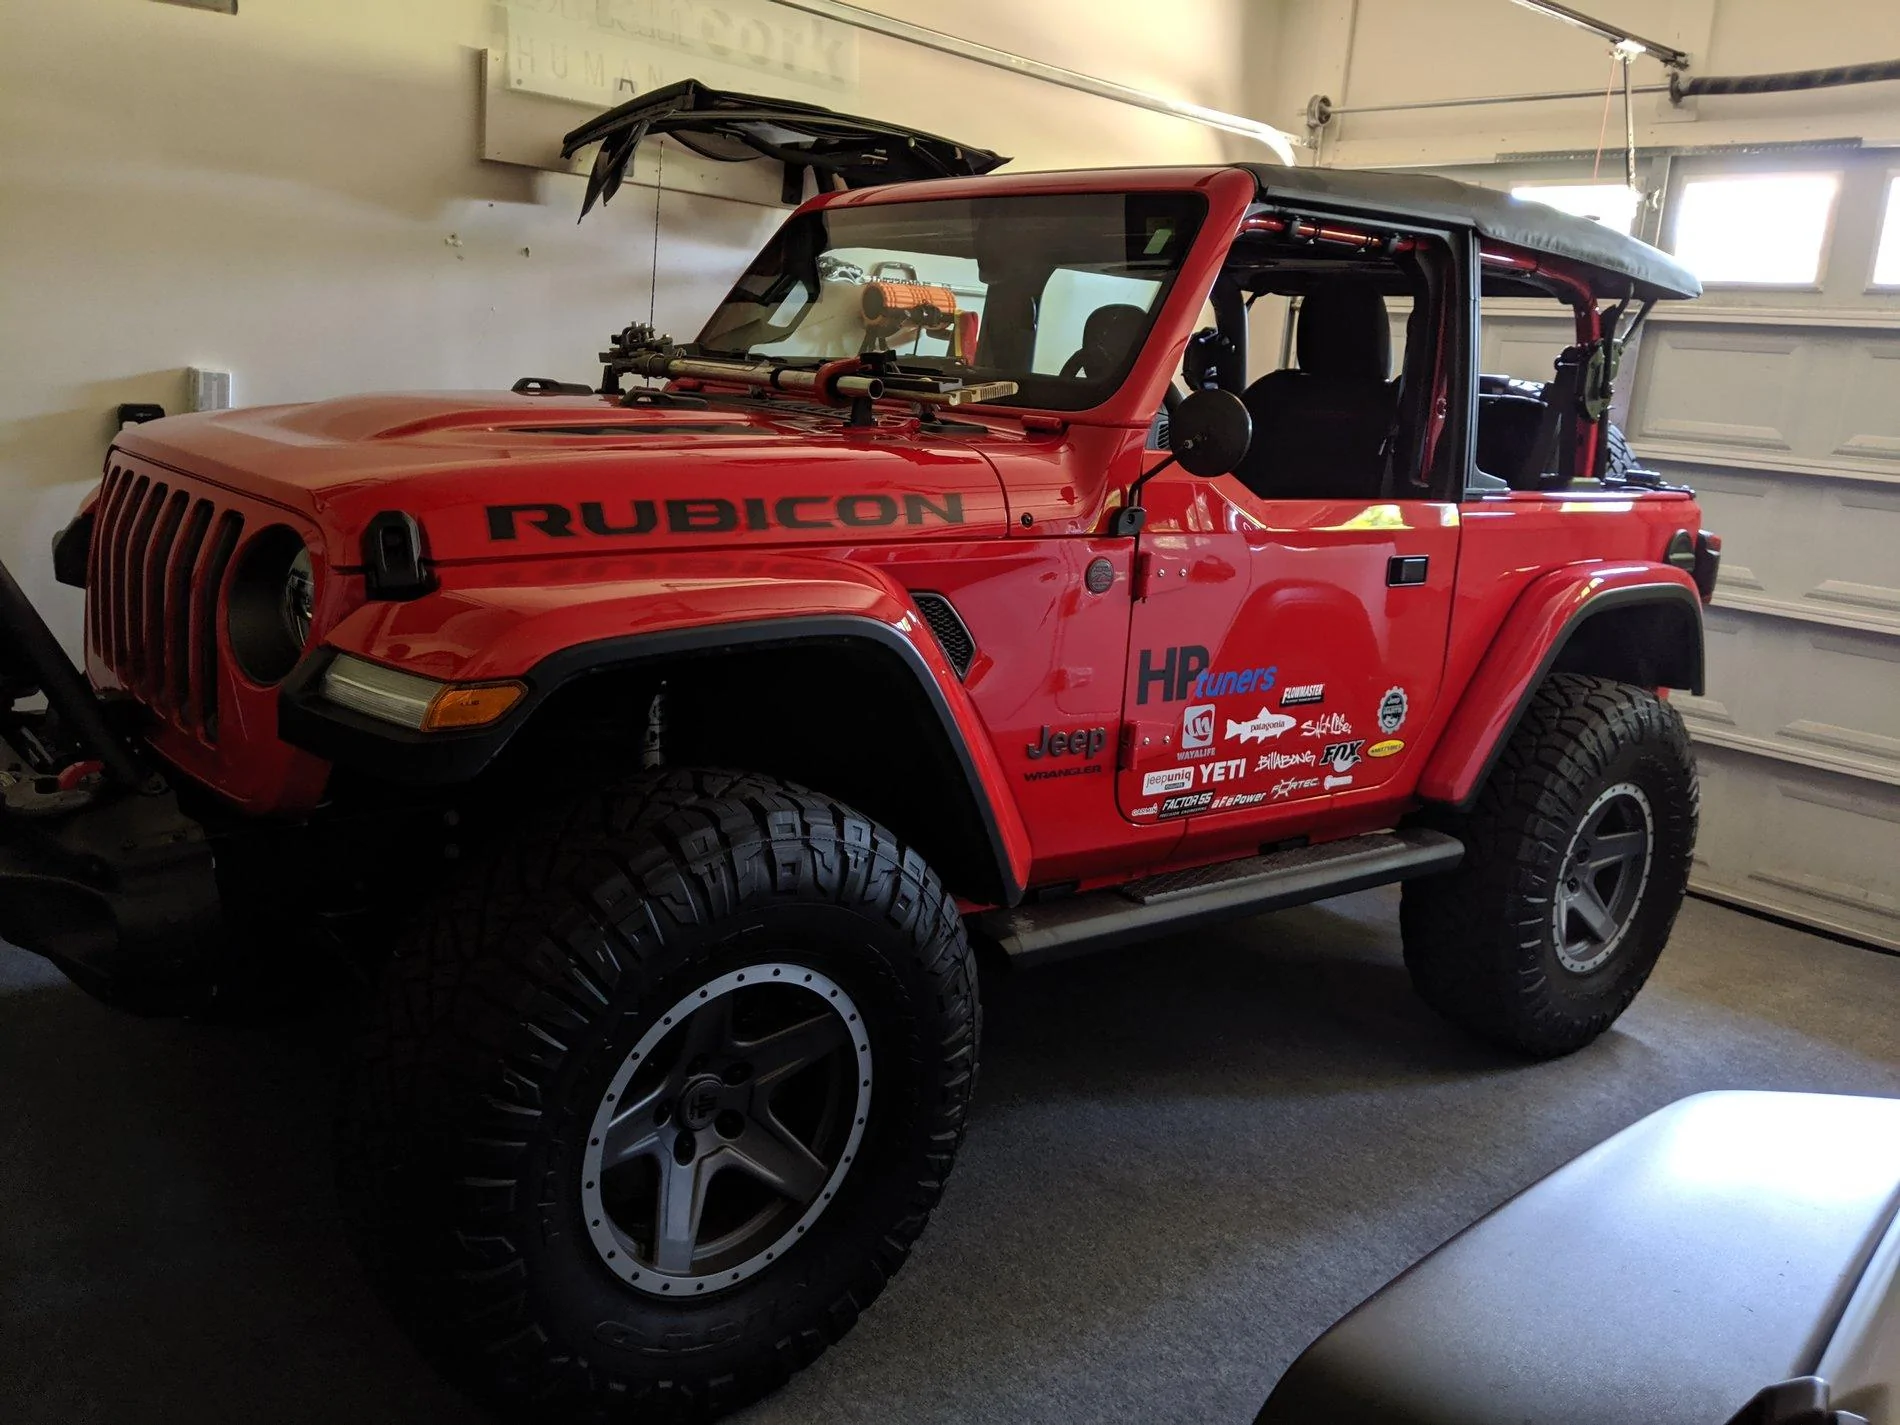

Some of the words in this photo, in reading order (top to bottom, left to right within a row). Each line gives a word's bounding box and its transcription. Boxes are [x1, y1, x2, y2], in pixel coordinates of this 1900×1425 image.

[485, 493, 965, 541] RUBICON
[1137, 645, 1209, 705] HP
[1195, 666, 1277, 698] tuners
[1282, 684, 1325, 704] FLOWMASTER
[1250, 721, 1285, 732] patagonia
[1027, 725, 1106, 760] Jeep
[1320, 740, 1365, 766] FOX
[1177, 748, 1216, 760] WAYALIFE
[1024, 765, 1101, 781] WRANGLER
[1200, 758, 1246, 783] YETI
[1162, 795, 1199, 810] FACTOR
[1198, 792, 1213, 804] 55
